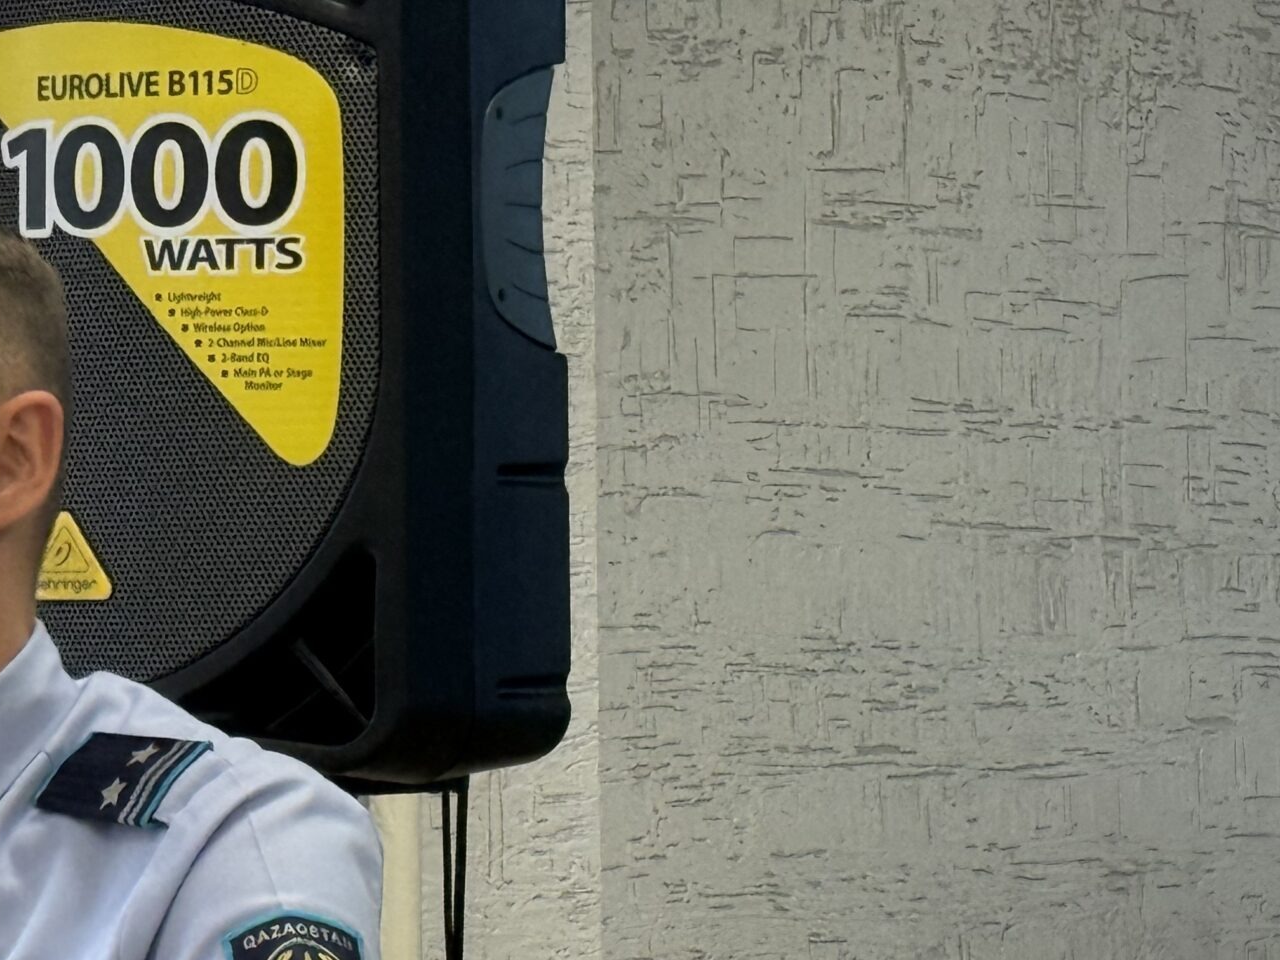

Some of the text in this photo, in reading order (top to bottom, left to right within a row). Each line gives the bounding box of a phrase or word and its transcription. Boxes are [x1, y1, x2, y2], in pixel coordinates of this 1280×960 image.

[37, 67, 259, 101] EUROLIVE B115D
[5, 116, 300, 234] 1000
[144, 236, 303, 271] WATTS
[167, 291, 222, 304] Lightweight
[234, 306, 269, 317] Class-D
[193, 322, 266, 334] Wireless Option
[299, 337, 327, 347] Mixer
[256, 353, 270, 363] EQ
[233, 367, 313, 380] Main PA or Stage
[244, 381, 283, 391] Monitor
[39, 579, 98, 594] ehringer
